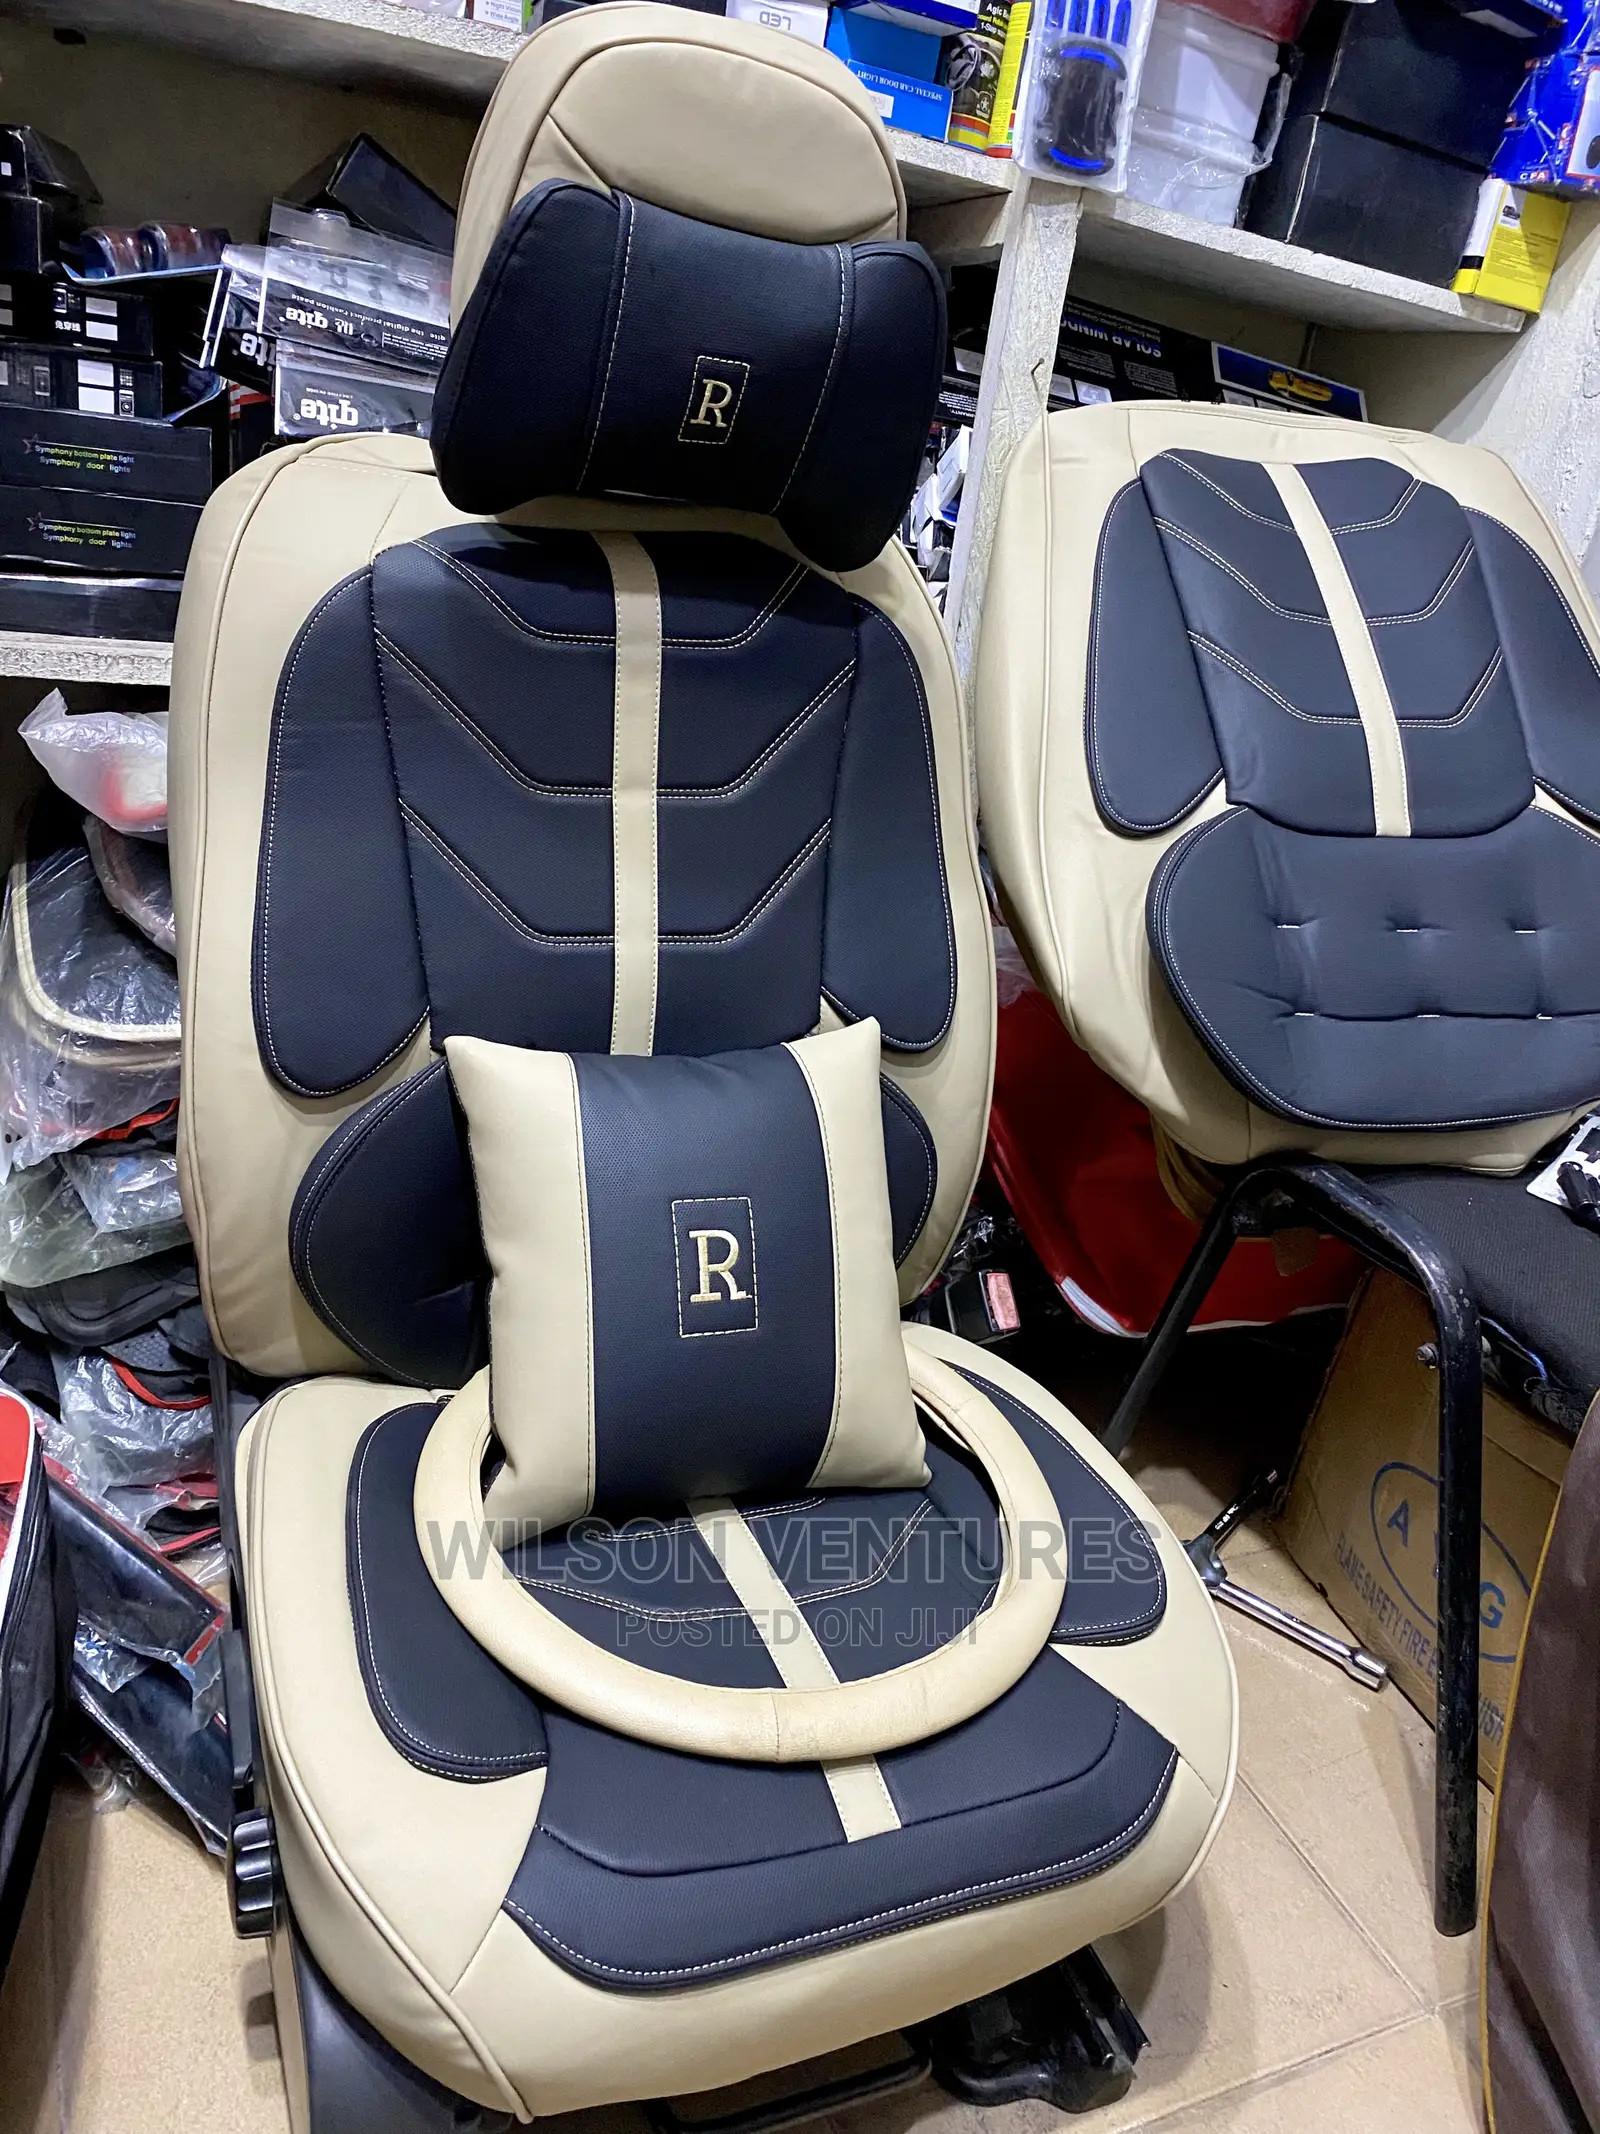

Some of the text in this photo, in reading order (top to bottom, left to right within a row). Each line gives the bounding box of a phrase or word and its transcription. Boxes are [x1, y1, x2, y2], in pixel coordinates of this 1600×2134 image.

[760, 11, 791, 30] LED
[857, 69, 942, 101] SPECIAL CAR DOOR LIGHT
[285, 306, 328, 329] qite
[1112, 332, 1162, 358] SOLAR
[300, 398, 358, 430] qite
[690, 379, 732, 427] R
[35, 444, 135, 464] Symphony bottom plate light
[39, 456, 131, 473] Symphony door lights
[38, 522, 137, 540] Symphony bottom plate light
[42, 532, 133, 549] Symphony door lights
[689, 1230, 752, 1302] R
[1399, 1613, 1431, 1669] FIRE
